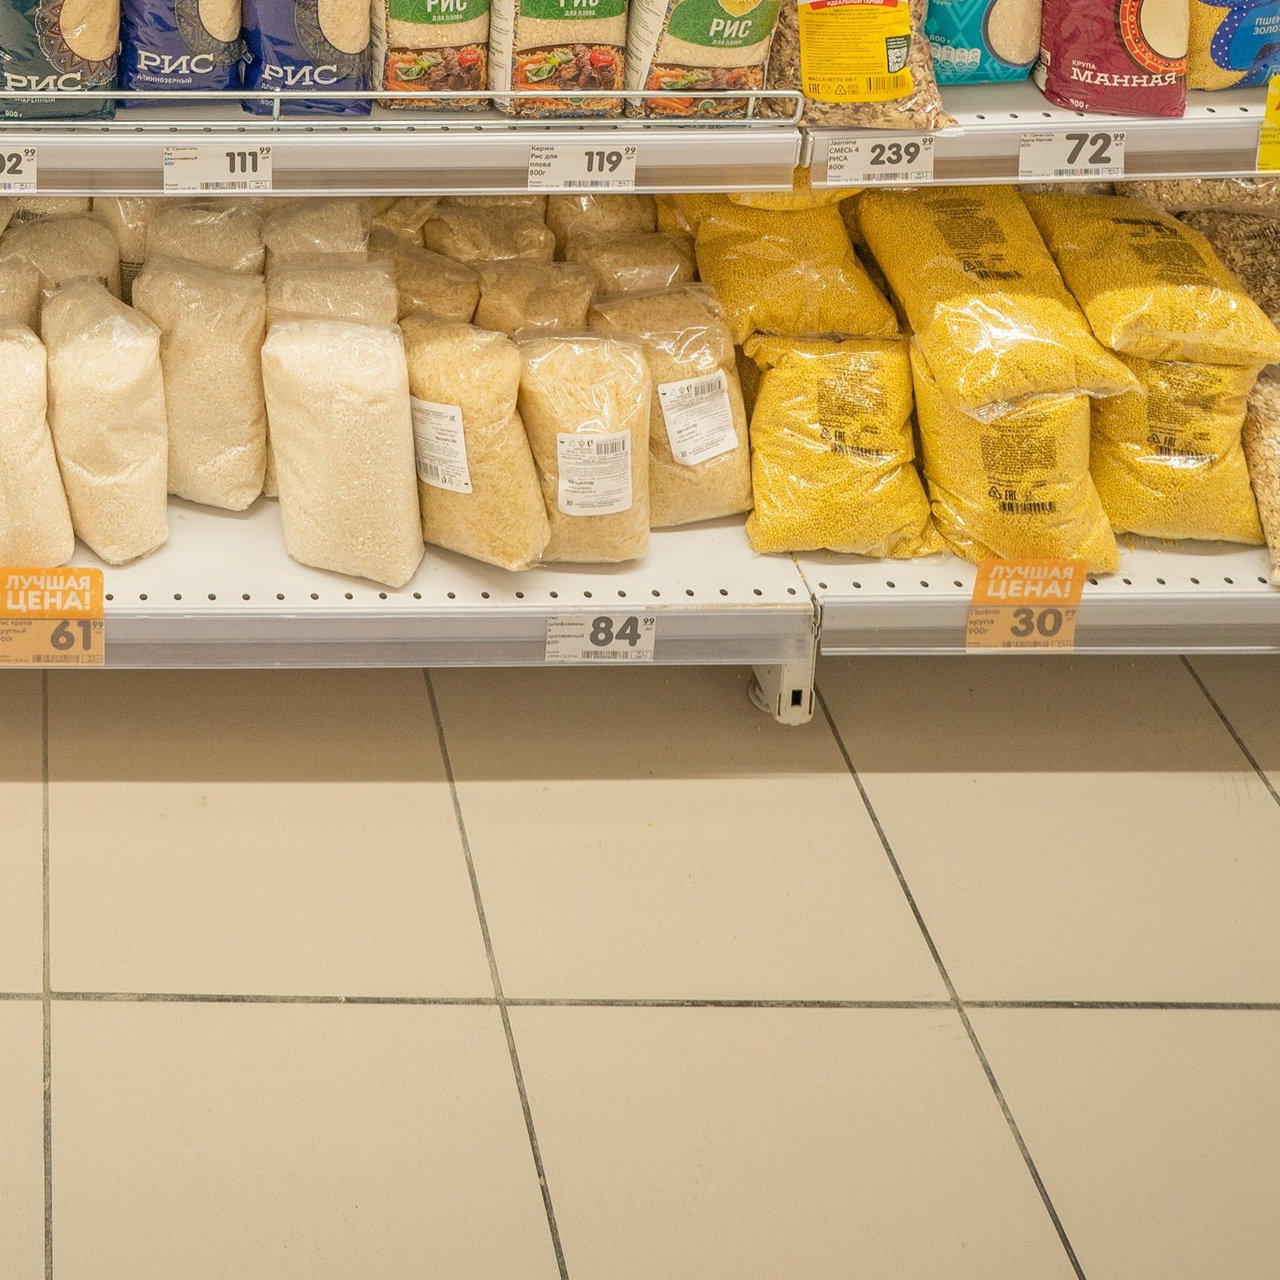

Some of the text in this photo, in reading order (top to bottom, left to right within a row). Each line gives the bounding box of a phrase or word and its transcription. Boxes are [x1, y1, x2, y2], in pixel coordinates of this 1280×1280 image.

[1071, 67, 1177, 87] МАННАЯ
[584, 151, 622, 173] 119
[870, 142, 921, 165] 239
[1065, 132, 1112, 165] 72
[50, 620, 92, 651] 61
[590, 616, 641, 647] 84
[1009, 608, 1063, 637] 30
